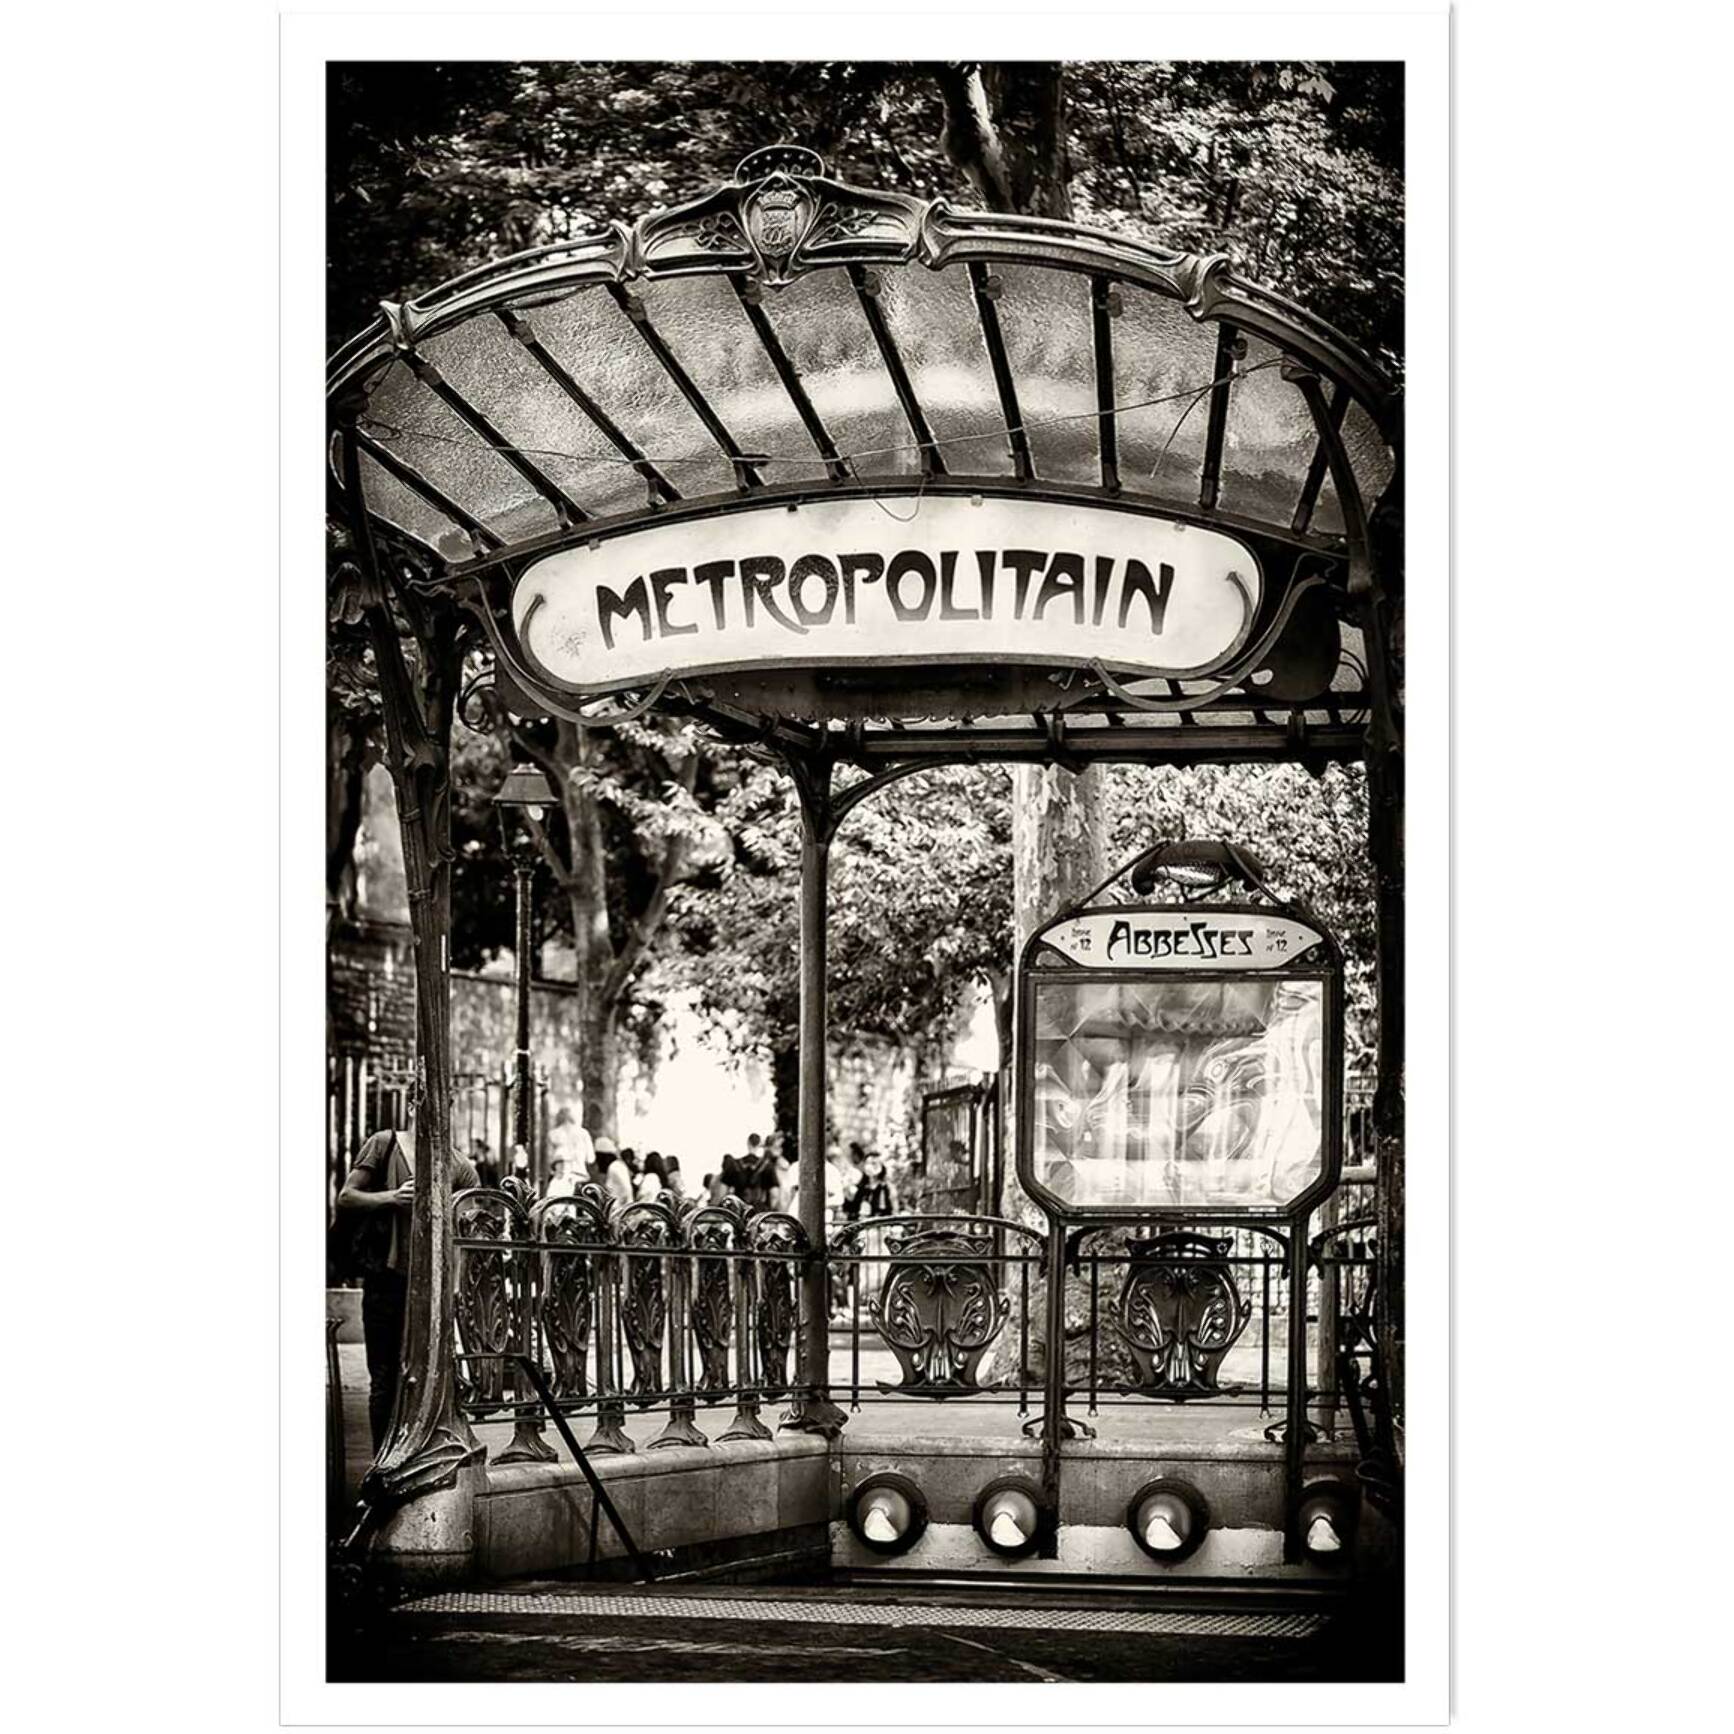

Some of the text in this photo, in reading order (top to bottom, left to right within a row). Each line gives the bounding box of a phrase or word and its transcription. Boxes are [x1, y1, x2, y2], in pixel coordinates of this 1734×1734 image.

[596, 549, 1175, 649] METROPOLITAIN
[1079, 938, 1091, 951] 12
[1107, 920, 1254, 960] ABBESSES
[1276, 939, 1287, 952] 12
